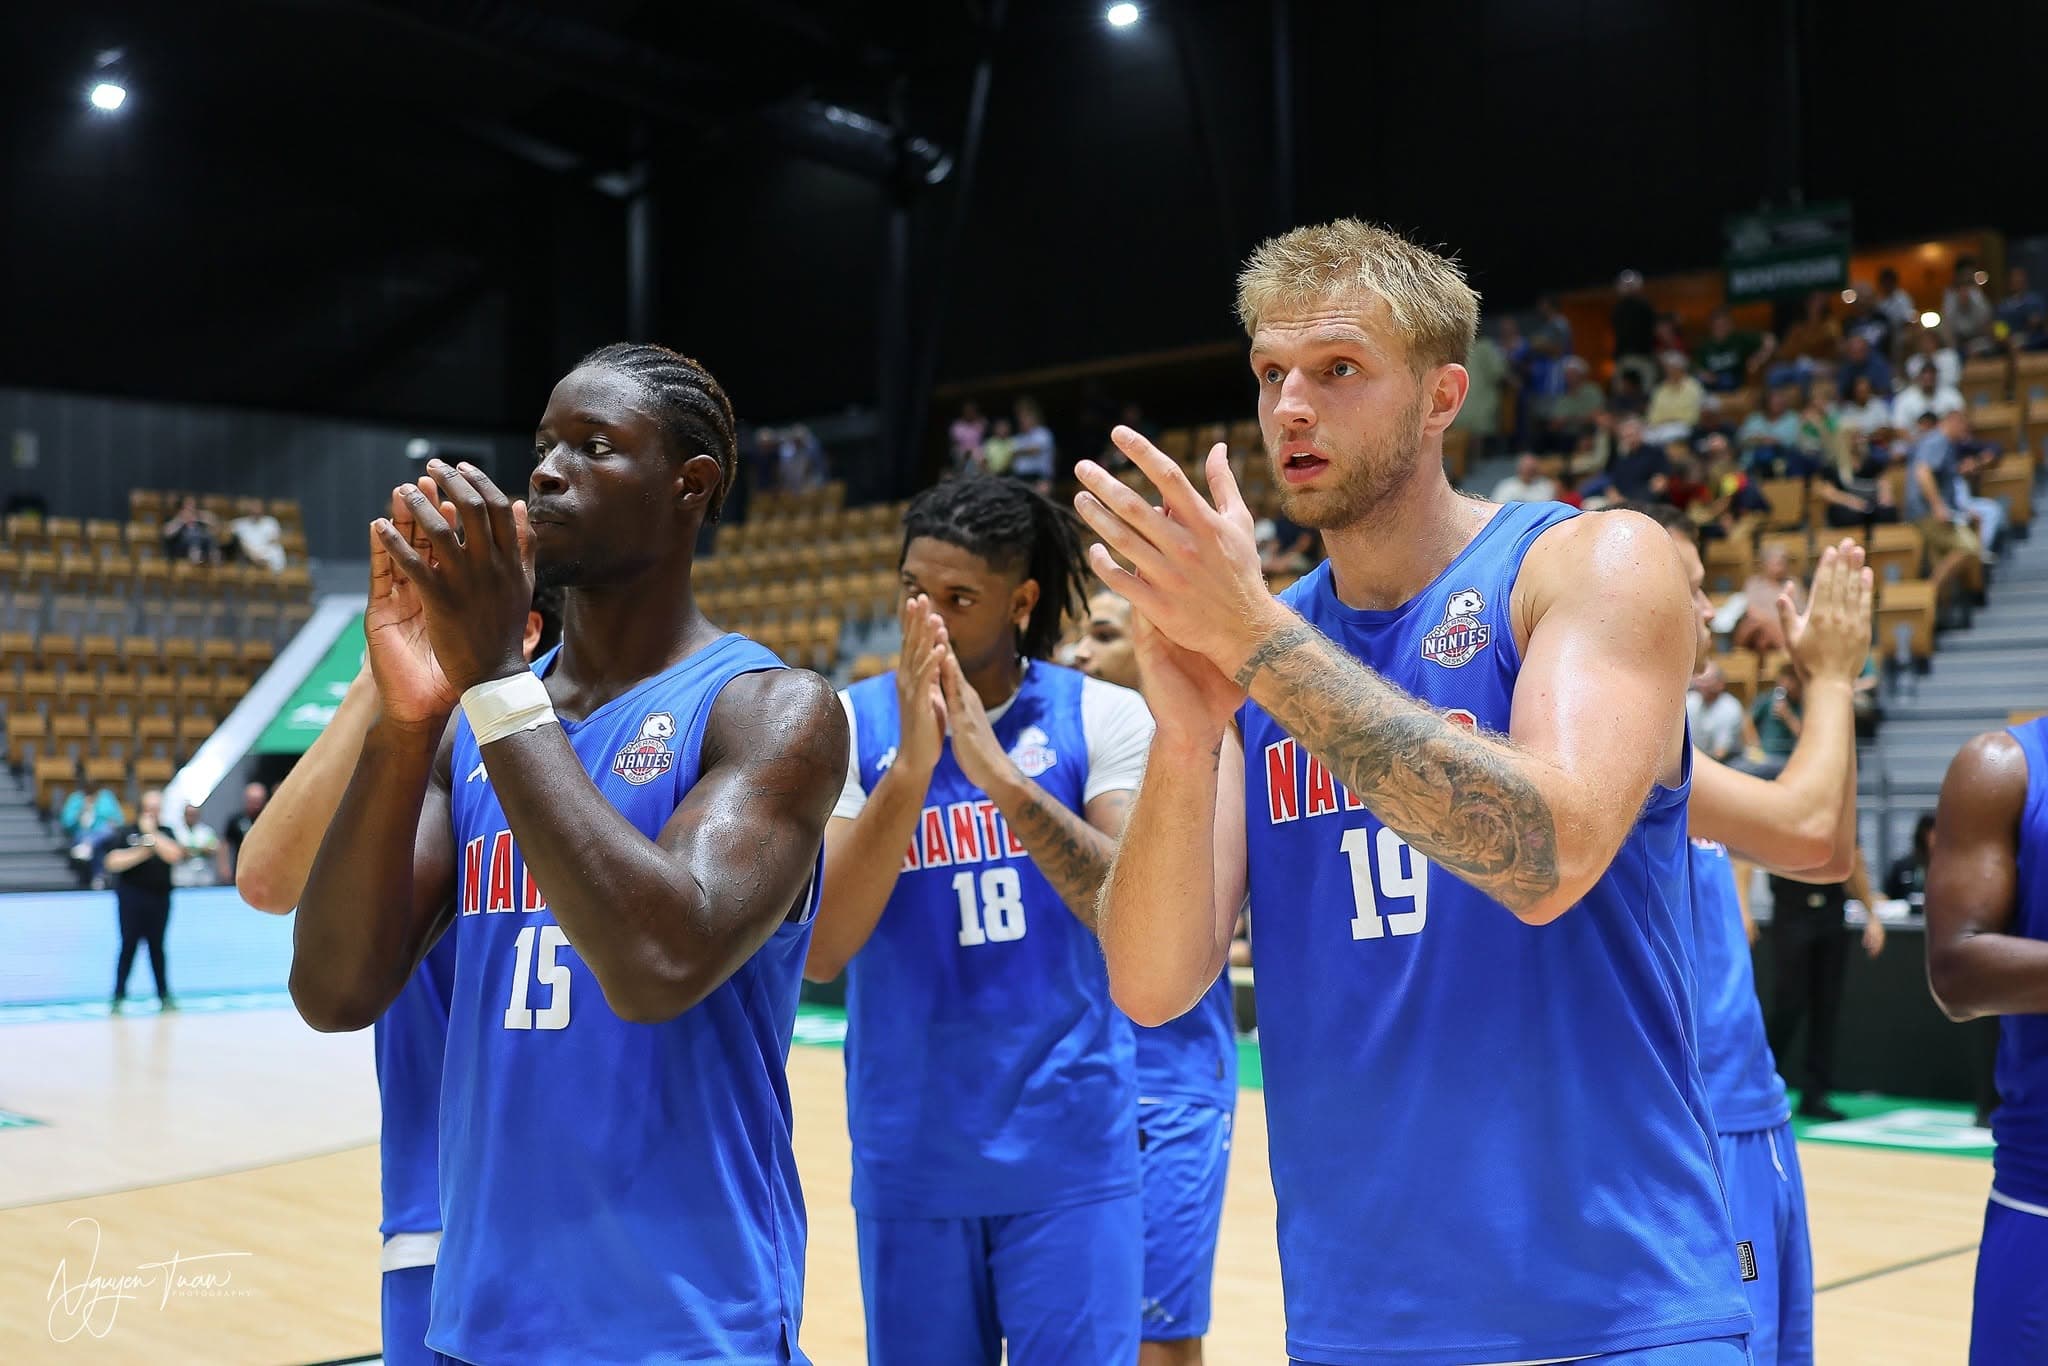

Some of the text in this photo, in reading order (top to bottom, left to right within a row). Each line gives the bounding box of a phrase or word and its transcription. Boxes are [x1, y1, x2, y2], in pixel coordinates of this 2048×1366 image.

[1425, 627, 1487, 655] NANTES
[1442, 651, 1471, 665] BASKET
[616, 753, 671, 769] NANTES
[952, 867, 1028, 946] 18
[1340, 827, 1428, 940] 19
[504, 926, 571, 1029] 15
